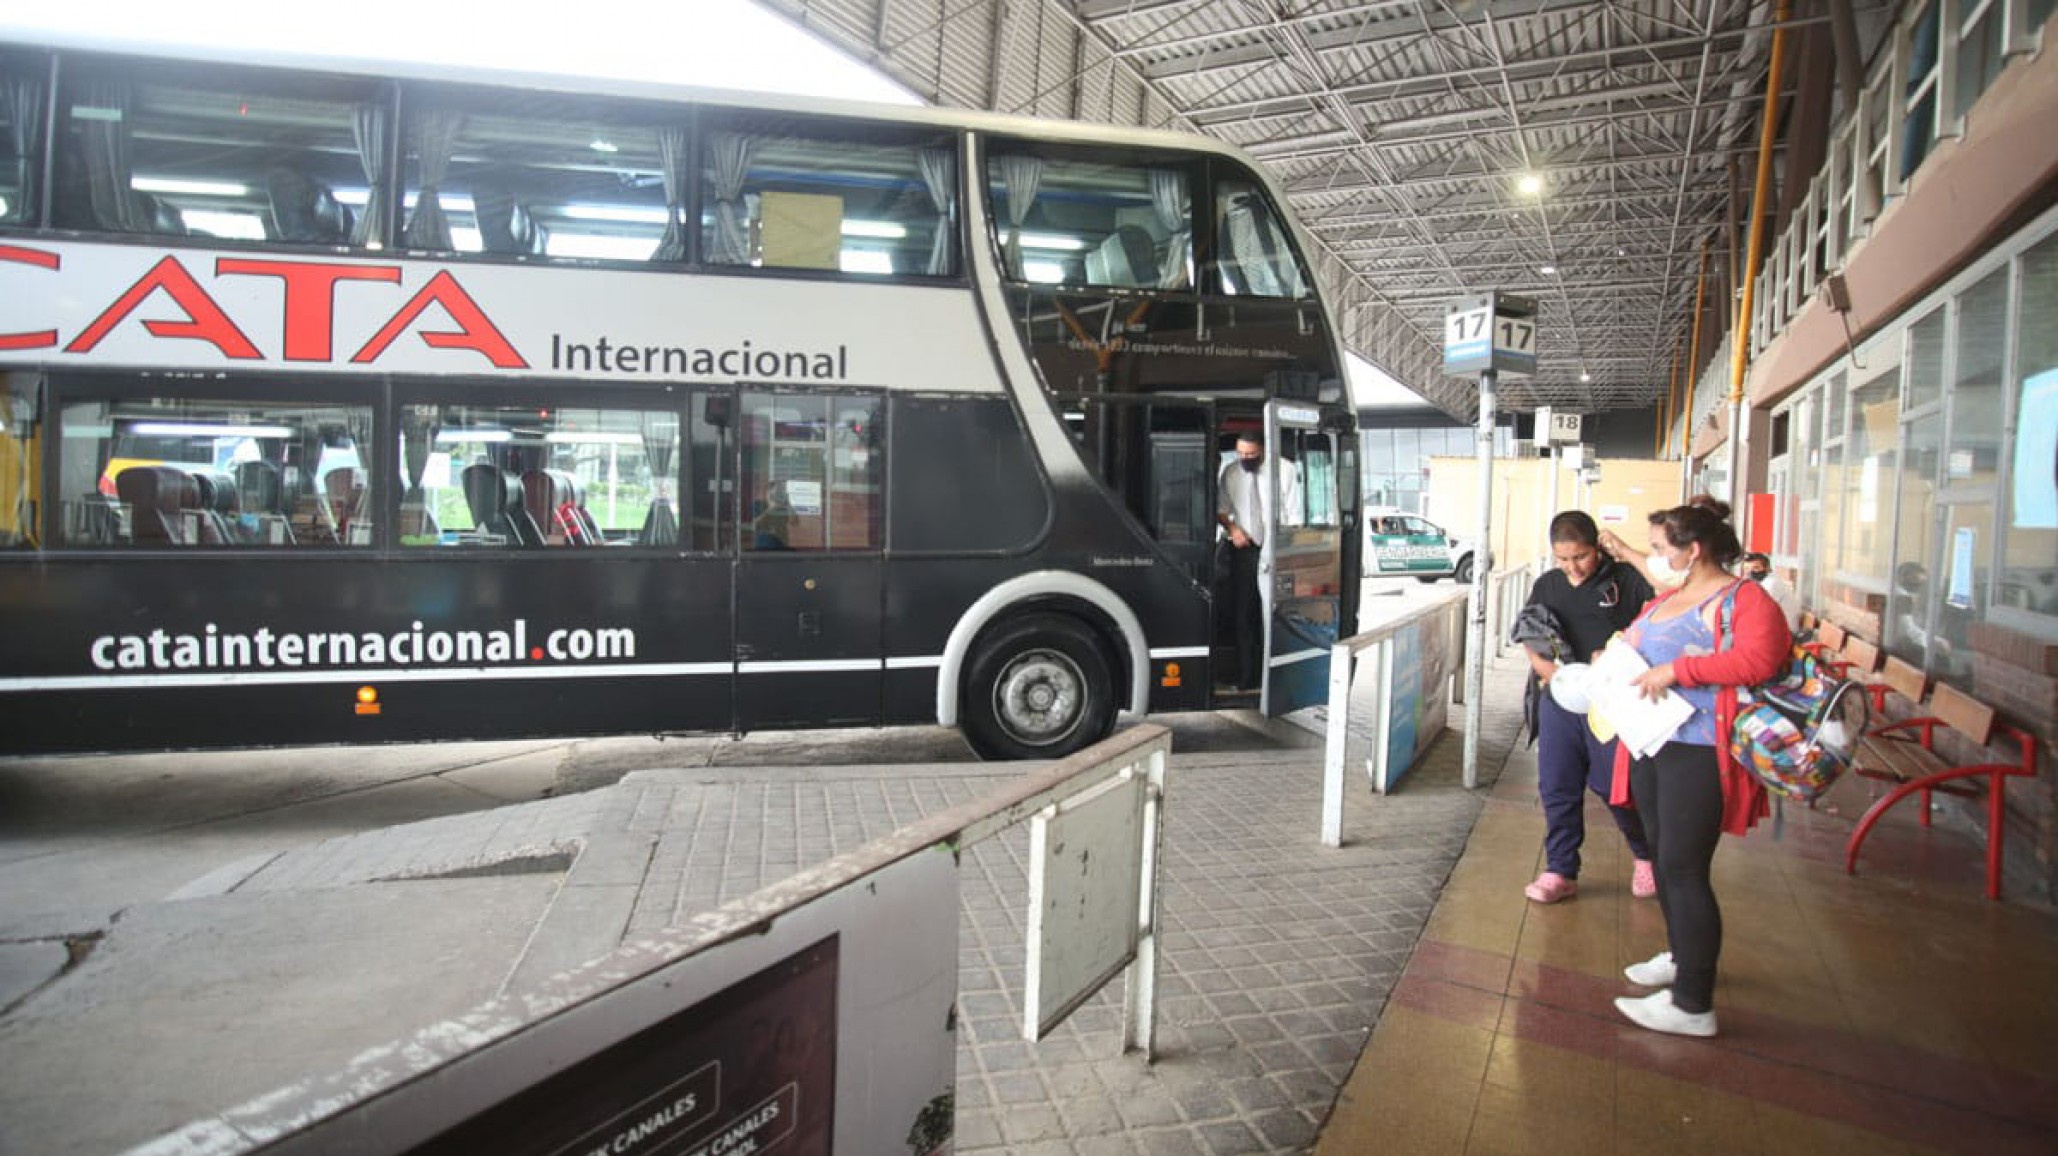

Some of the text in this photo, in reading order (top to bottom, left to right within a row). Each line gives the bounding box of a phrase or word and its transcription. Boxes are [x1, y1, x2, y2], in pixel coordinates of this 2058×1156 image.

[1454, 312, 1486, 341] 17
[1501, 321, 1533, 349] 17
[551, 333, 847, 379] Internacional
[1556, 416, 1579, 430] 18
[90, 619, 635, 669] catainternacional.com
[613, 1092, 697, 1154] CANALES
[712, 1101, 781, 1155] CANALES
